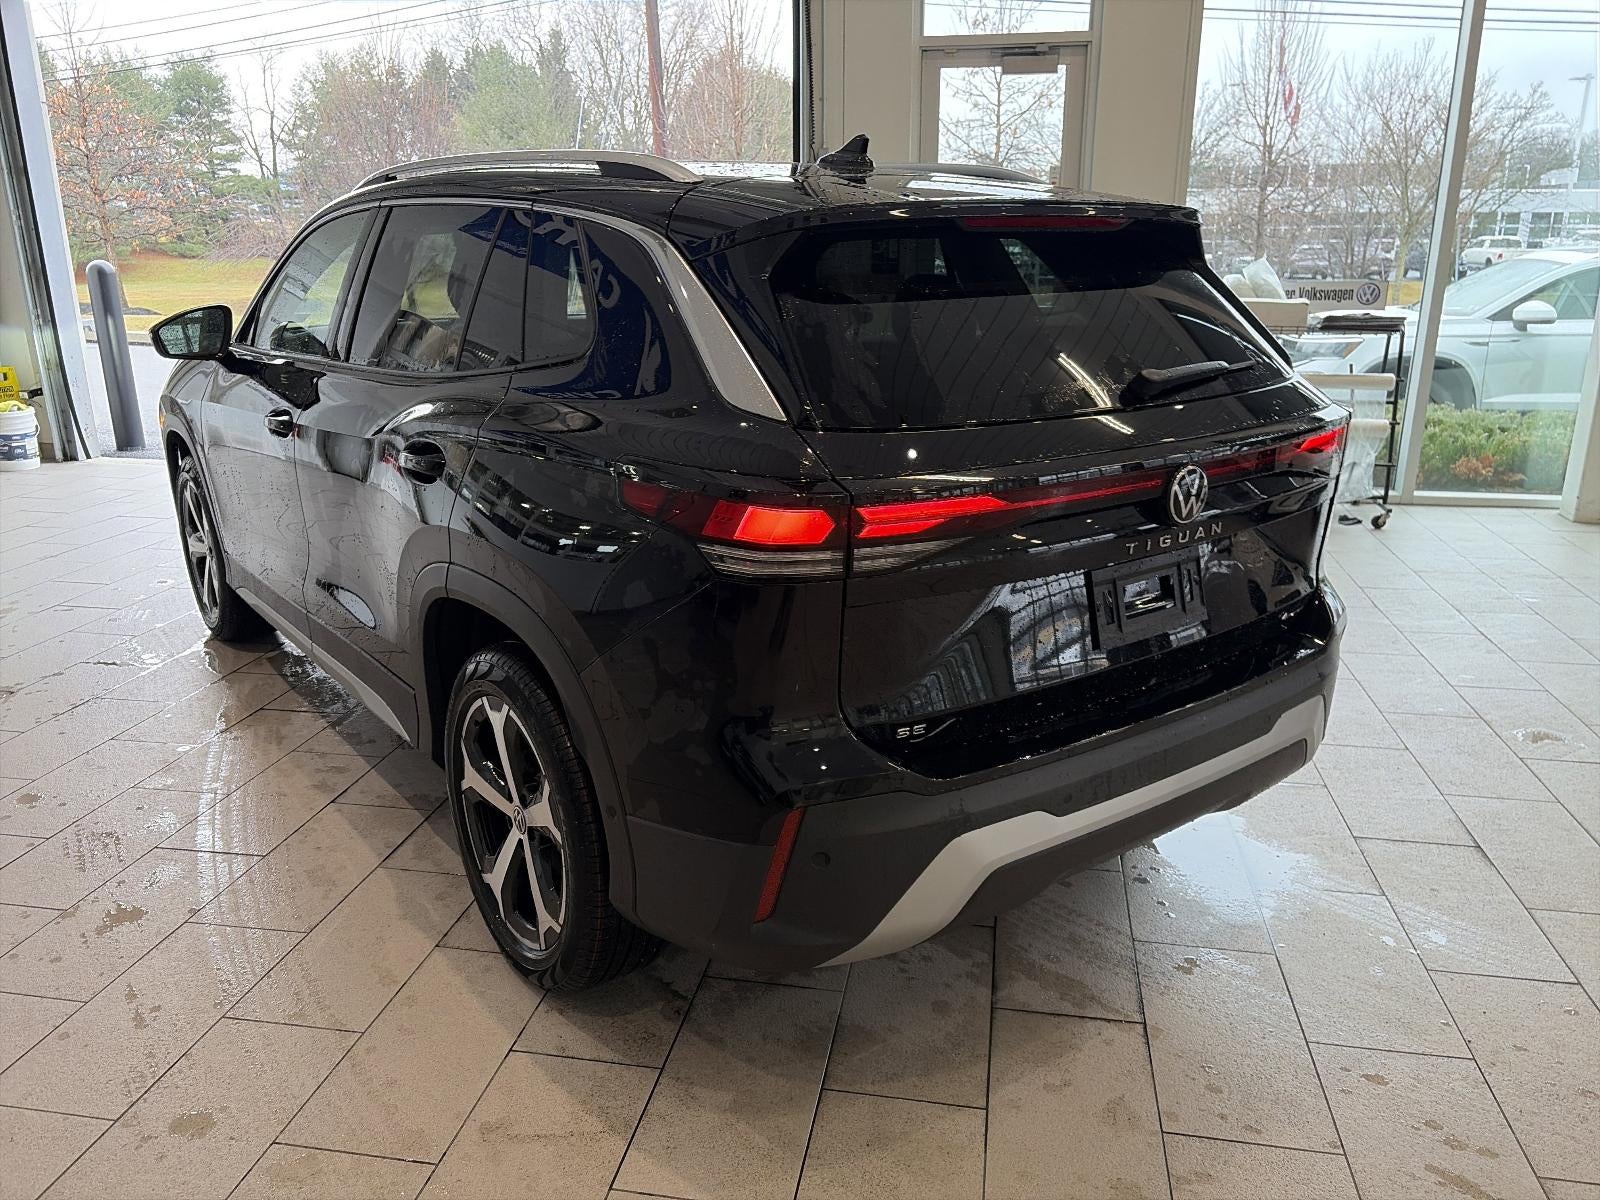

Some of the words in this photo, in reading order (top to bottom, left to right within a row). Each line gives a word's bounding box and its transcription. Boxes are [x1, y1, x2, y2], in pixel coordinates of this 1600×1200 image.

[1299, 286, 1354, 303] Volkswagen
[1126, 522, 1222, 555] TIGUAN
[896, 723, 927, 739] SE
